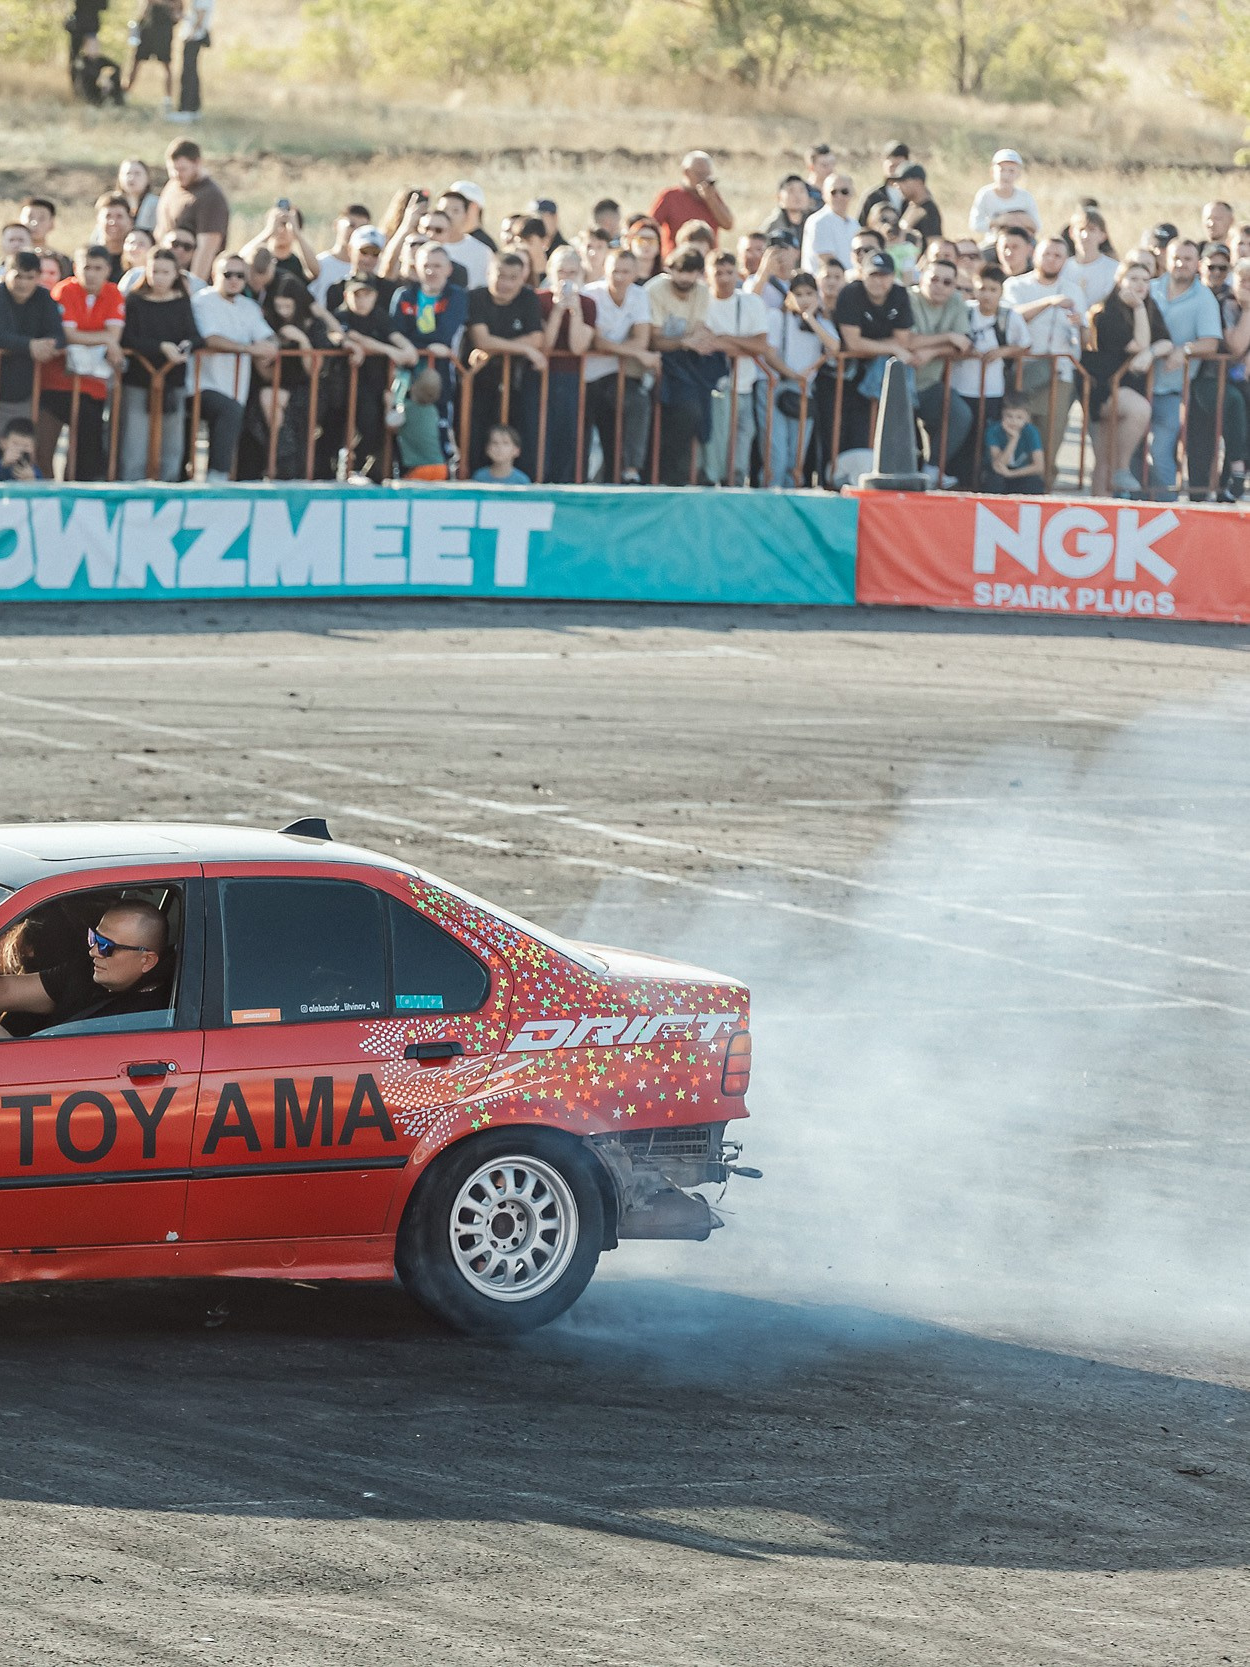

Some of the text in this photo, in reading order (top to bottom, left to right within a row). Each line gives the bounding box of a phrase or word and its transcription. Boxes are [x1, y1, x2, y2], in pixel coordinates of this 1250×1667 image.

[972, 501, 1181, 586] NGK
[972, 581, 1177, 616] SPARK PLUGS
[506, 1013, 741, 1053] DRIFT
